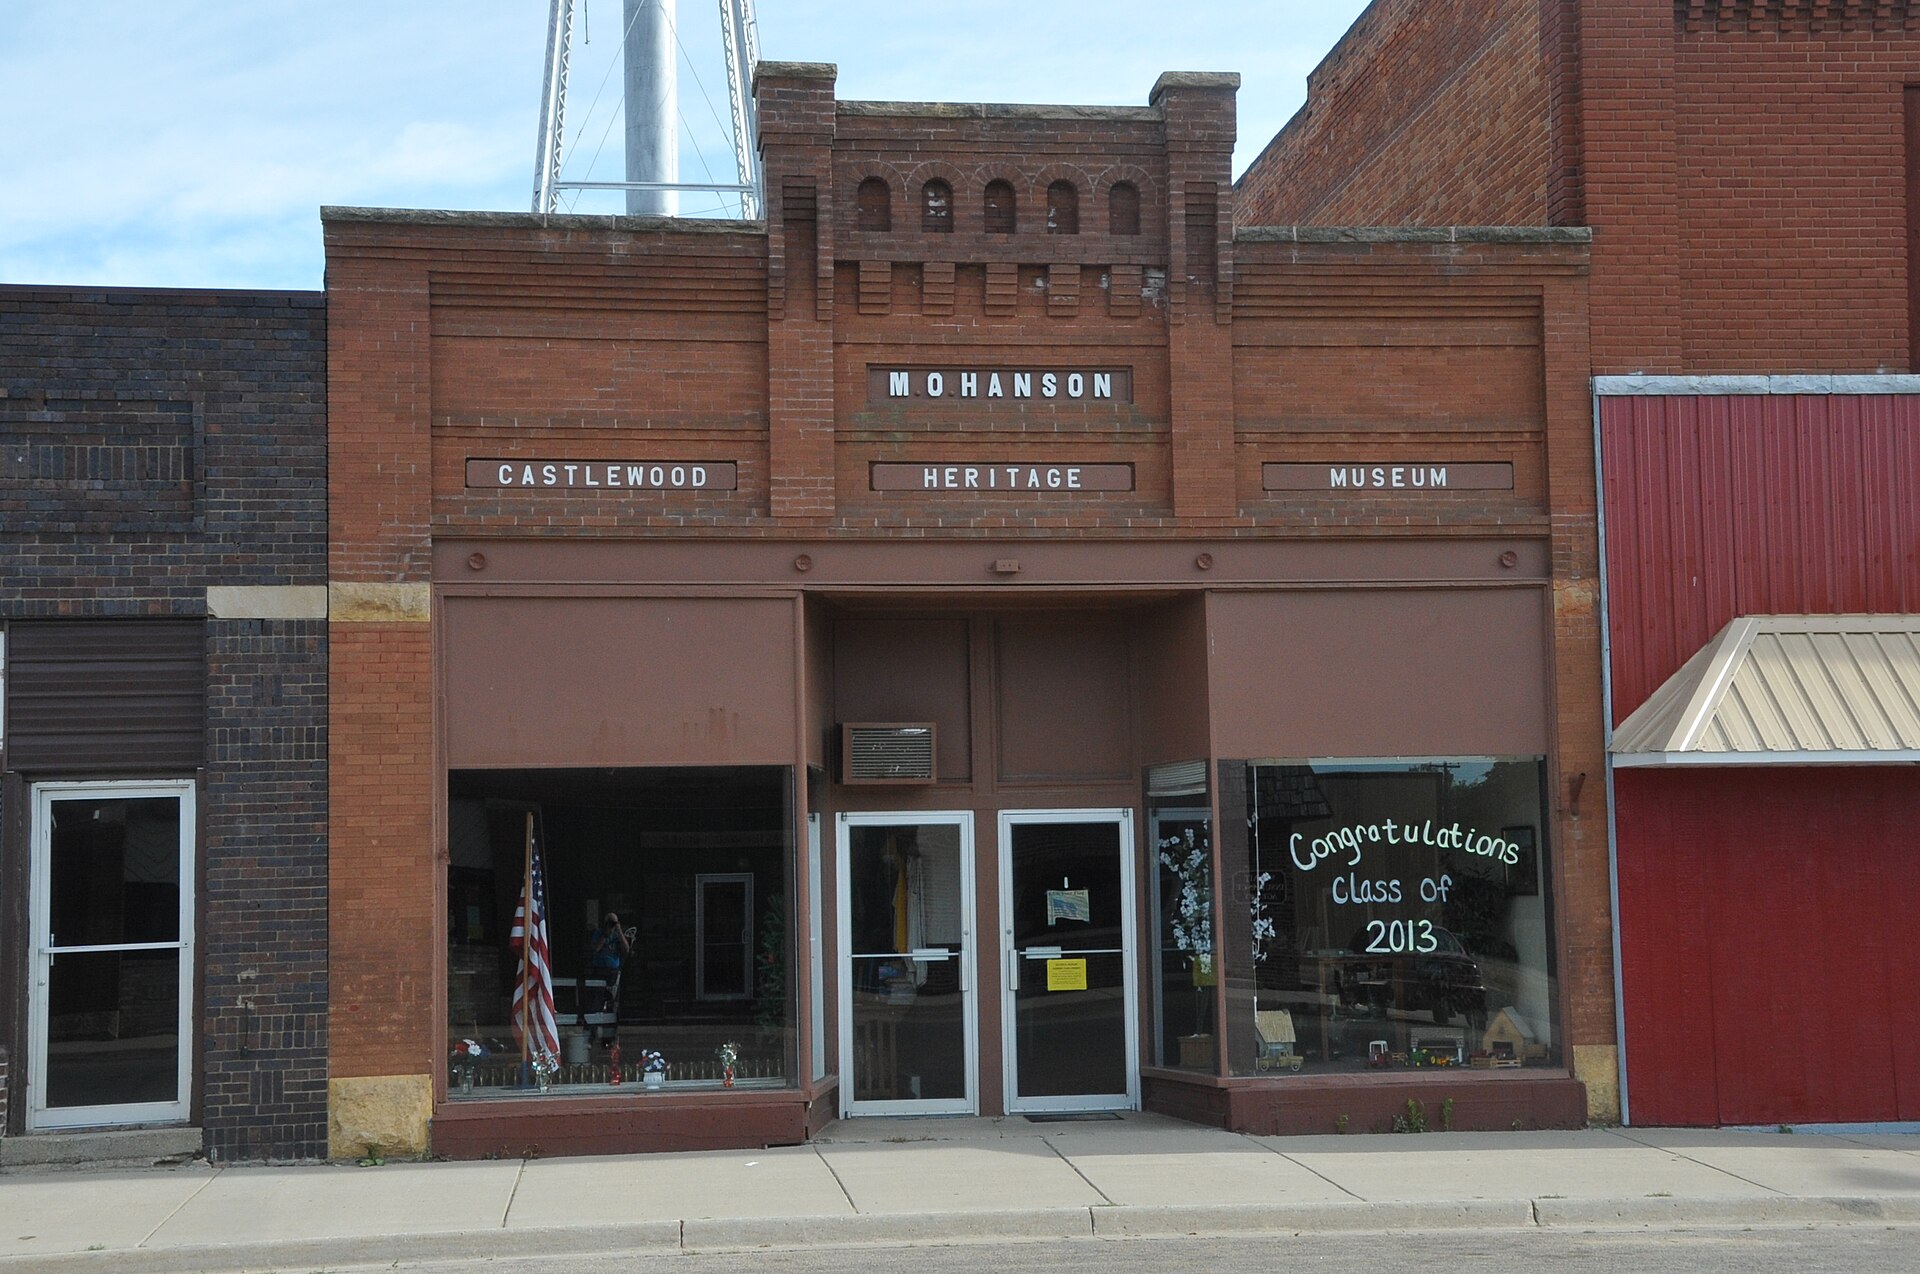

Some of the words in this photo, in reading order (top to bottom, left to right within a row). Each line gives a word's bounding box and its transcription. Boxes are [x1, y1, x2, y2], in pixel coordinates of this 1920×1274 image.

[498, 464, 707, 487] CASTLEWOOD
[923, 467, 1081, 488] HERITAGE
[1330, 467, 1447, 488] MUSEUM
[1289, 818, 1520, 871] Congratulations
[1365, 919, 1438, 953] 2013
